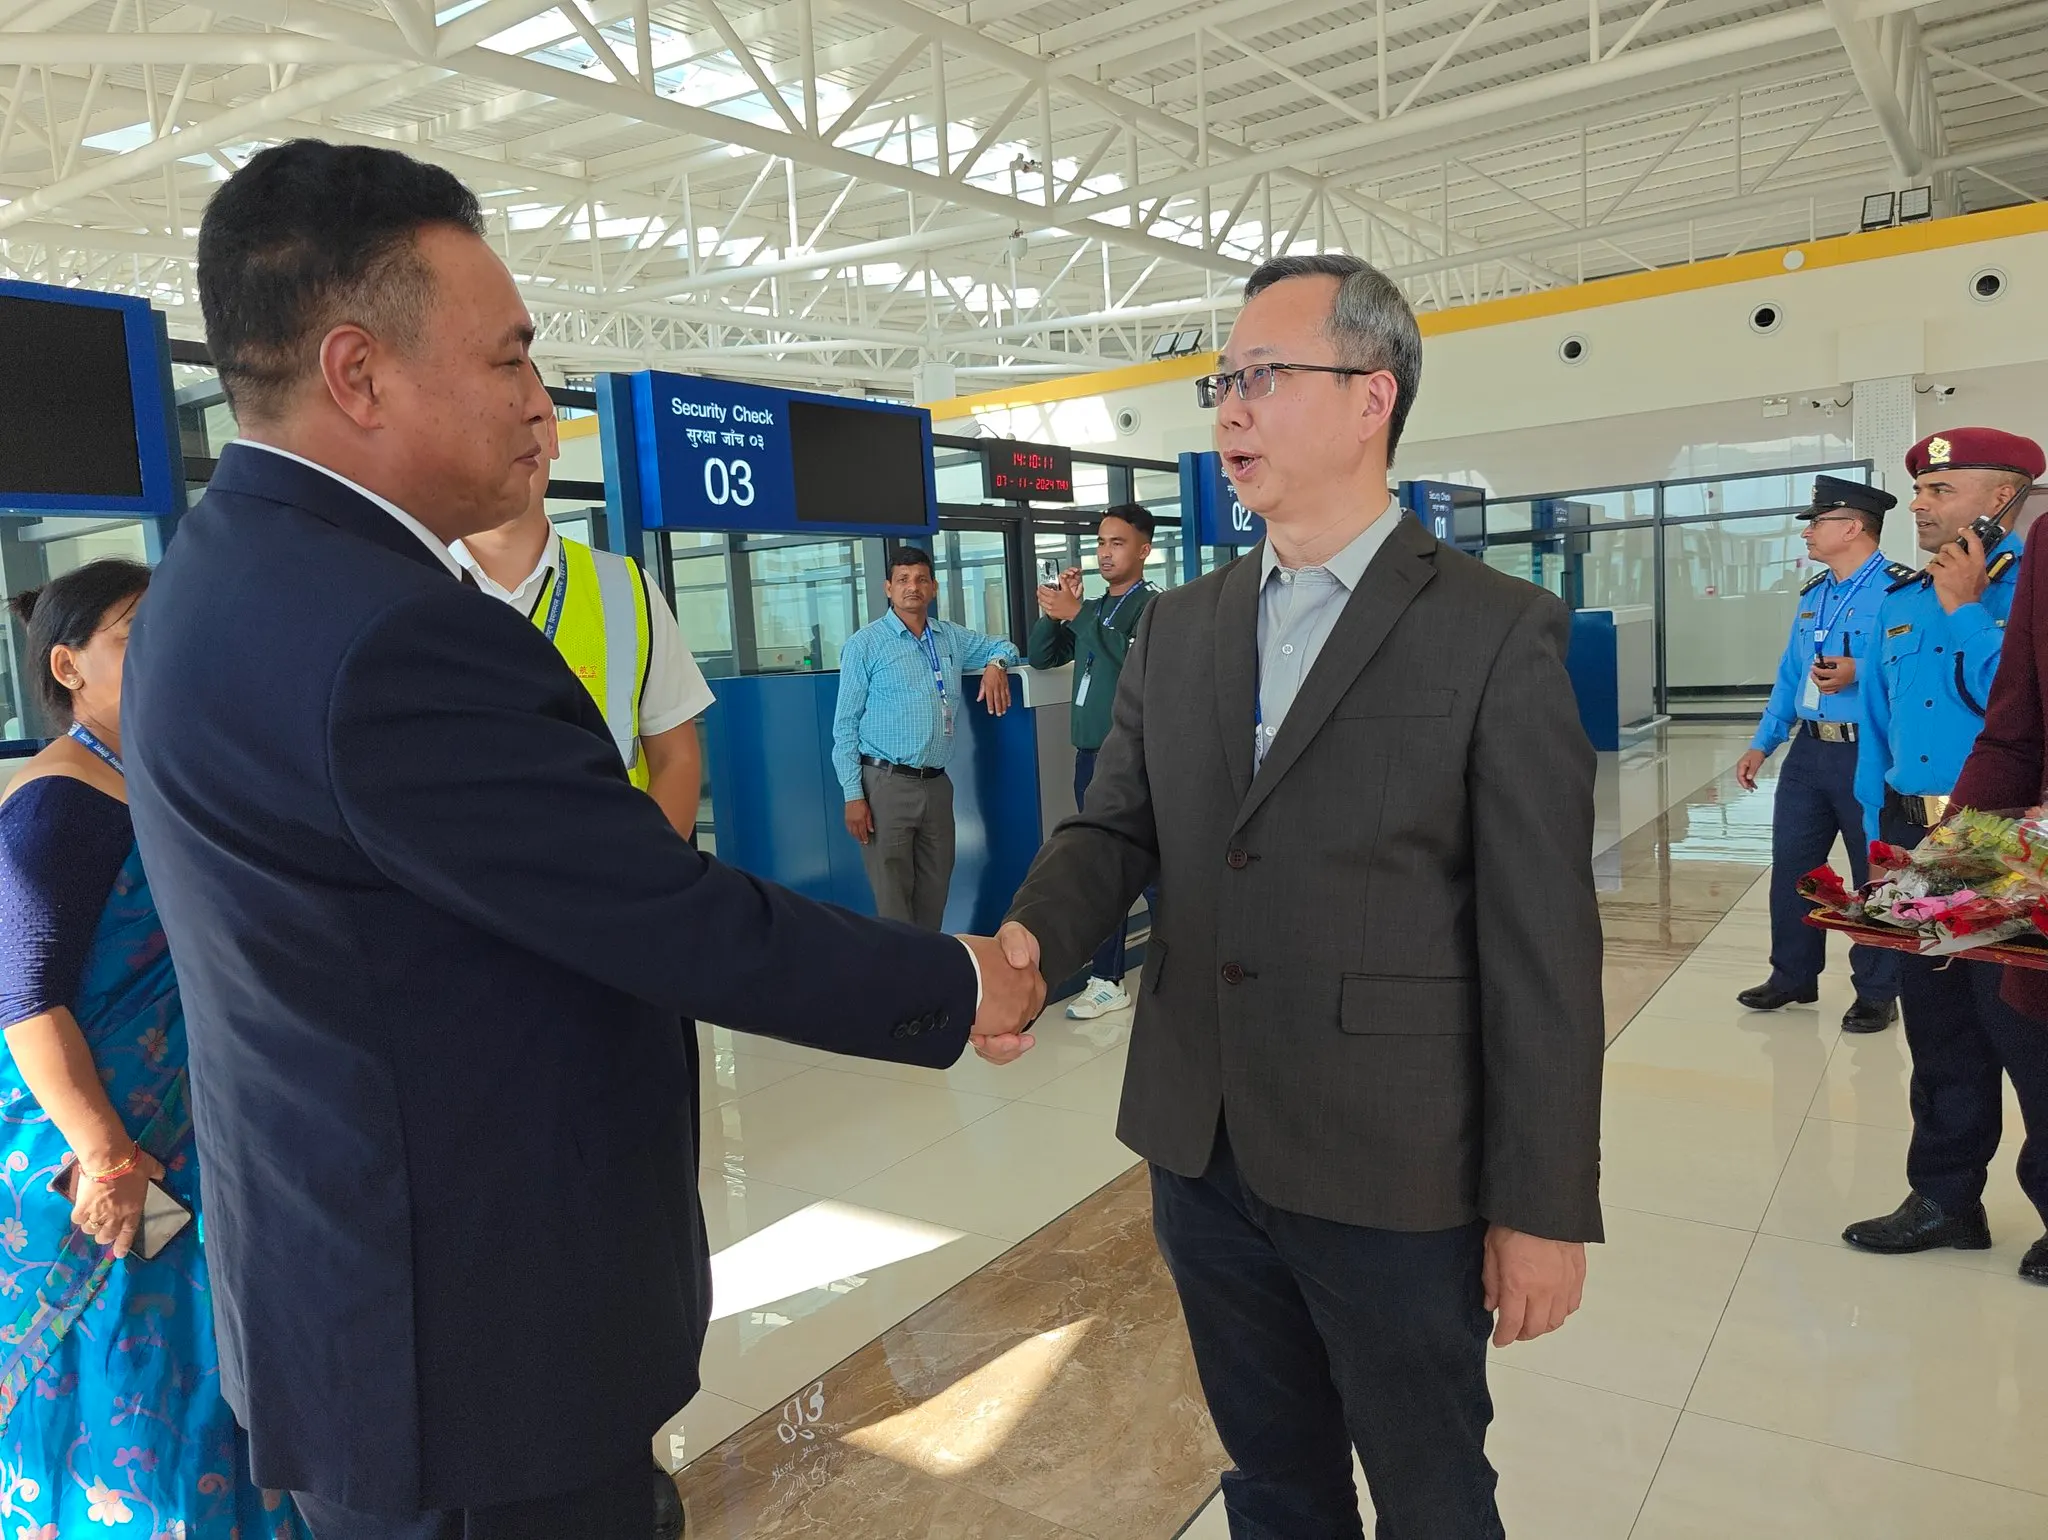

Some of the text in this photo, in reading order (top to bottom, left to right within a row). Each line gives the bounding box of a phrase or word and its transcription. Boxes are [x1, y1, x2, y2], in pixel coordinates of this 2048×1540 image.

[671, 397, 774, 425] Security Check
[685, 428, 717, 448] सुरक्षा
[749, 435, 765, 450] ०३
[1013, 453, 1053, 470] 14:10:11
[704, 457, 755, 506] 03
[1232, 501, 1253, 531] 02
[1434, 516, 1447, 539] 01
